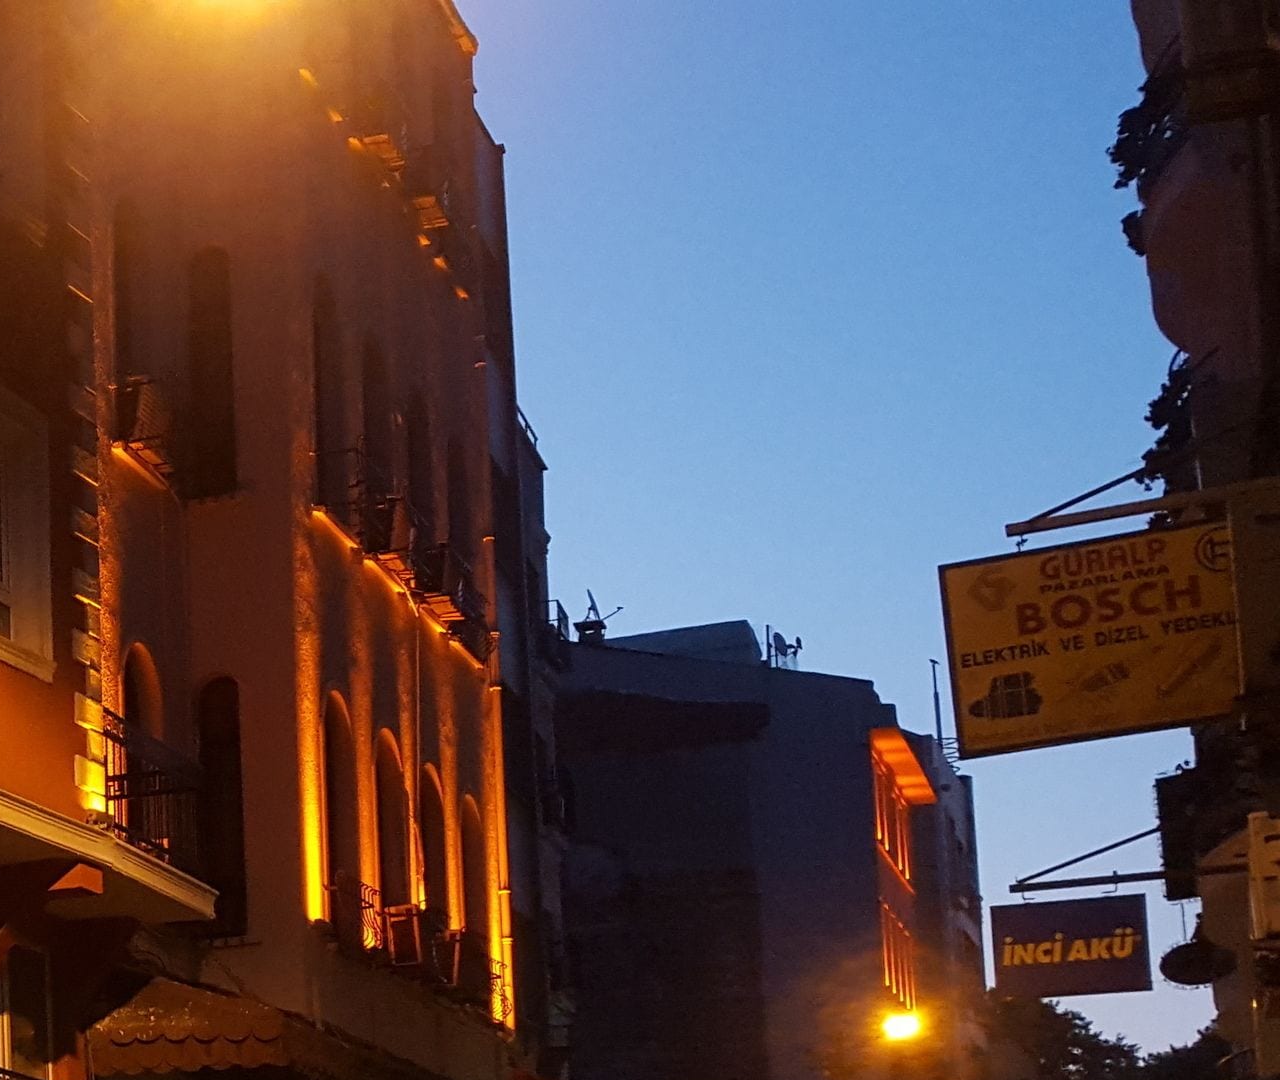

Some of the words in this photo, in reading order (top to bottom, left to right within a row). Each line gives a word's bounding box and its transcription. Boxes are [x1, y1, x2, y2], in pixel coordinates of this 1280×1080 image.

[1016, 574, 1202, 636] BOSCH
[960, 638, 1051, 669] ELEKTRİK
[1059, 635, 1085, 652] VE
[1094, 624, 1150, 646] DİZEL
[1002, 931, 1065, 966] İNCİ
[1067, 927, 1135, 962] AKÜ
